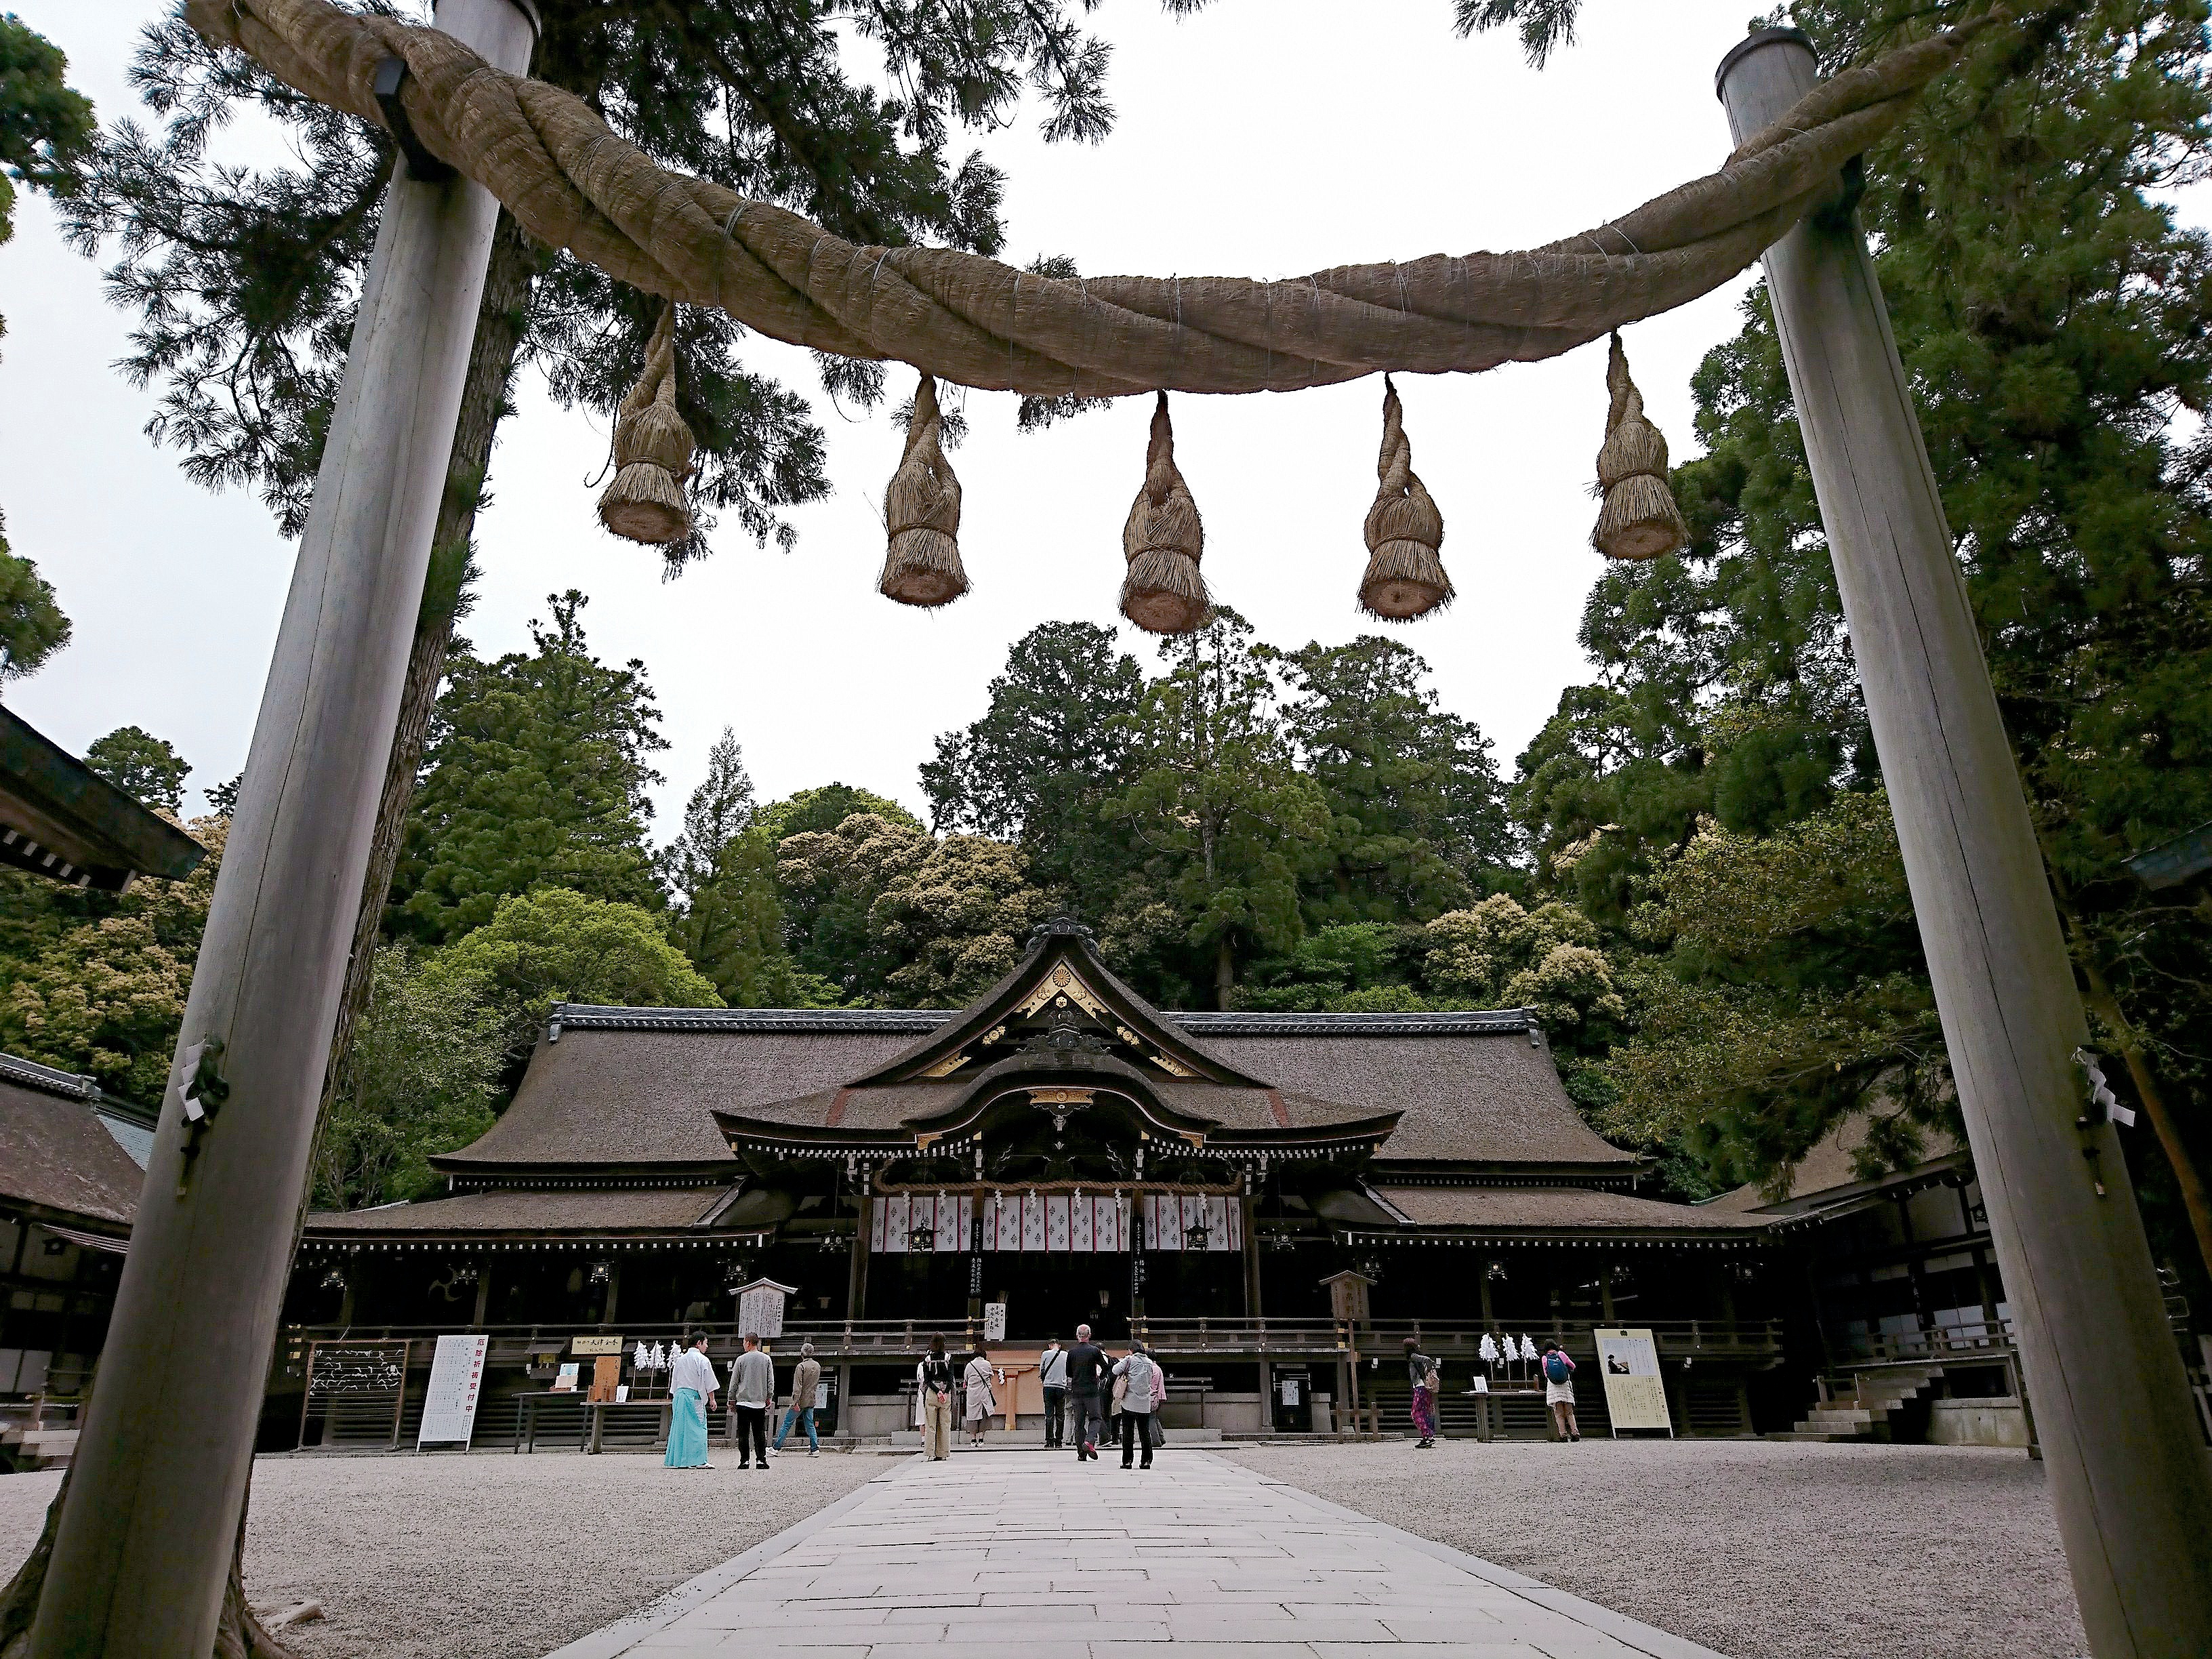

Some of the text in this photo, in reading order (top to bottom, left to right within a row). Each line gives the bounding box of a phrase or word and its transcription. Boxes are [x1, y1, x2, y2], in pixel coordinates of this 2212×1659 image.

[466, 1338, 485, 1412] 厄除祈祷受付中
